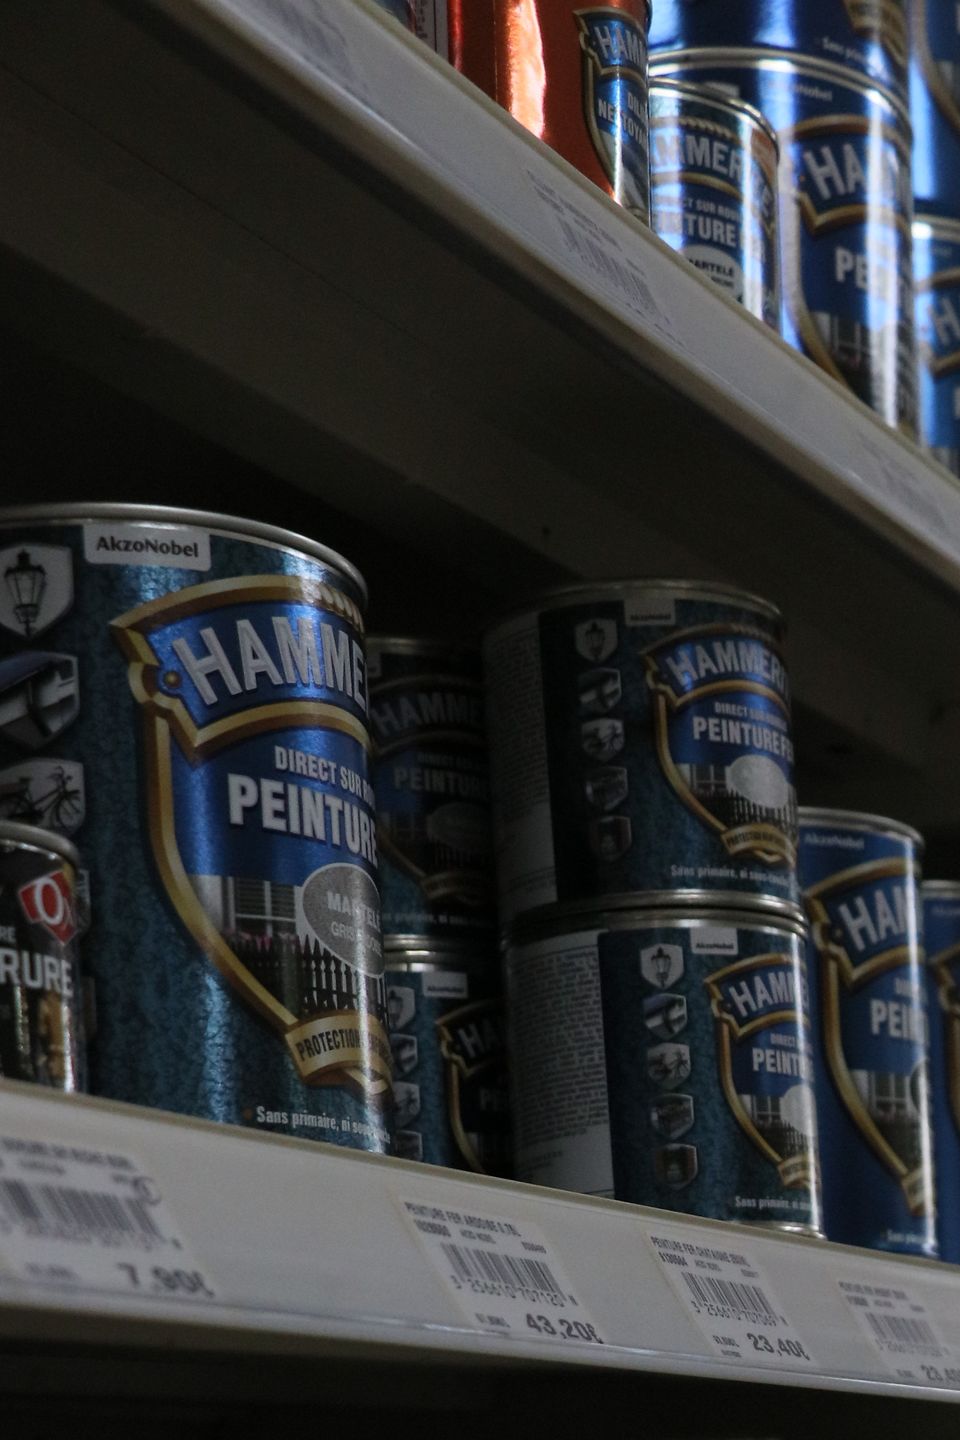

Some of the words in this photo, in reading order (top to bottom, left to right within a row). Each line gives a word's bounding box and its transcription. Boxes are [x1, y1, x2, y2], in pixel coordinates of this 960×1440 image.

[96, 535, 199, 559] AkzoNobel
[172, 615, 370, 708] HAMME
[274, 745, 336, 785] DIRECT
[340, 766, 363, 800] SUR
[256, 1105, 289, 1125] Sans
[292, 1110, 340, 1133] primaire,
[341, 1116, 351, 1133] ni
[525, 1312, 605, 1345] 43,20€
[746, 1332, 811, 1361] 23,40€
